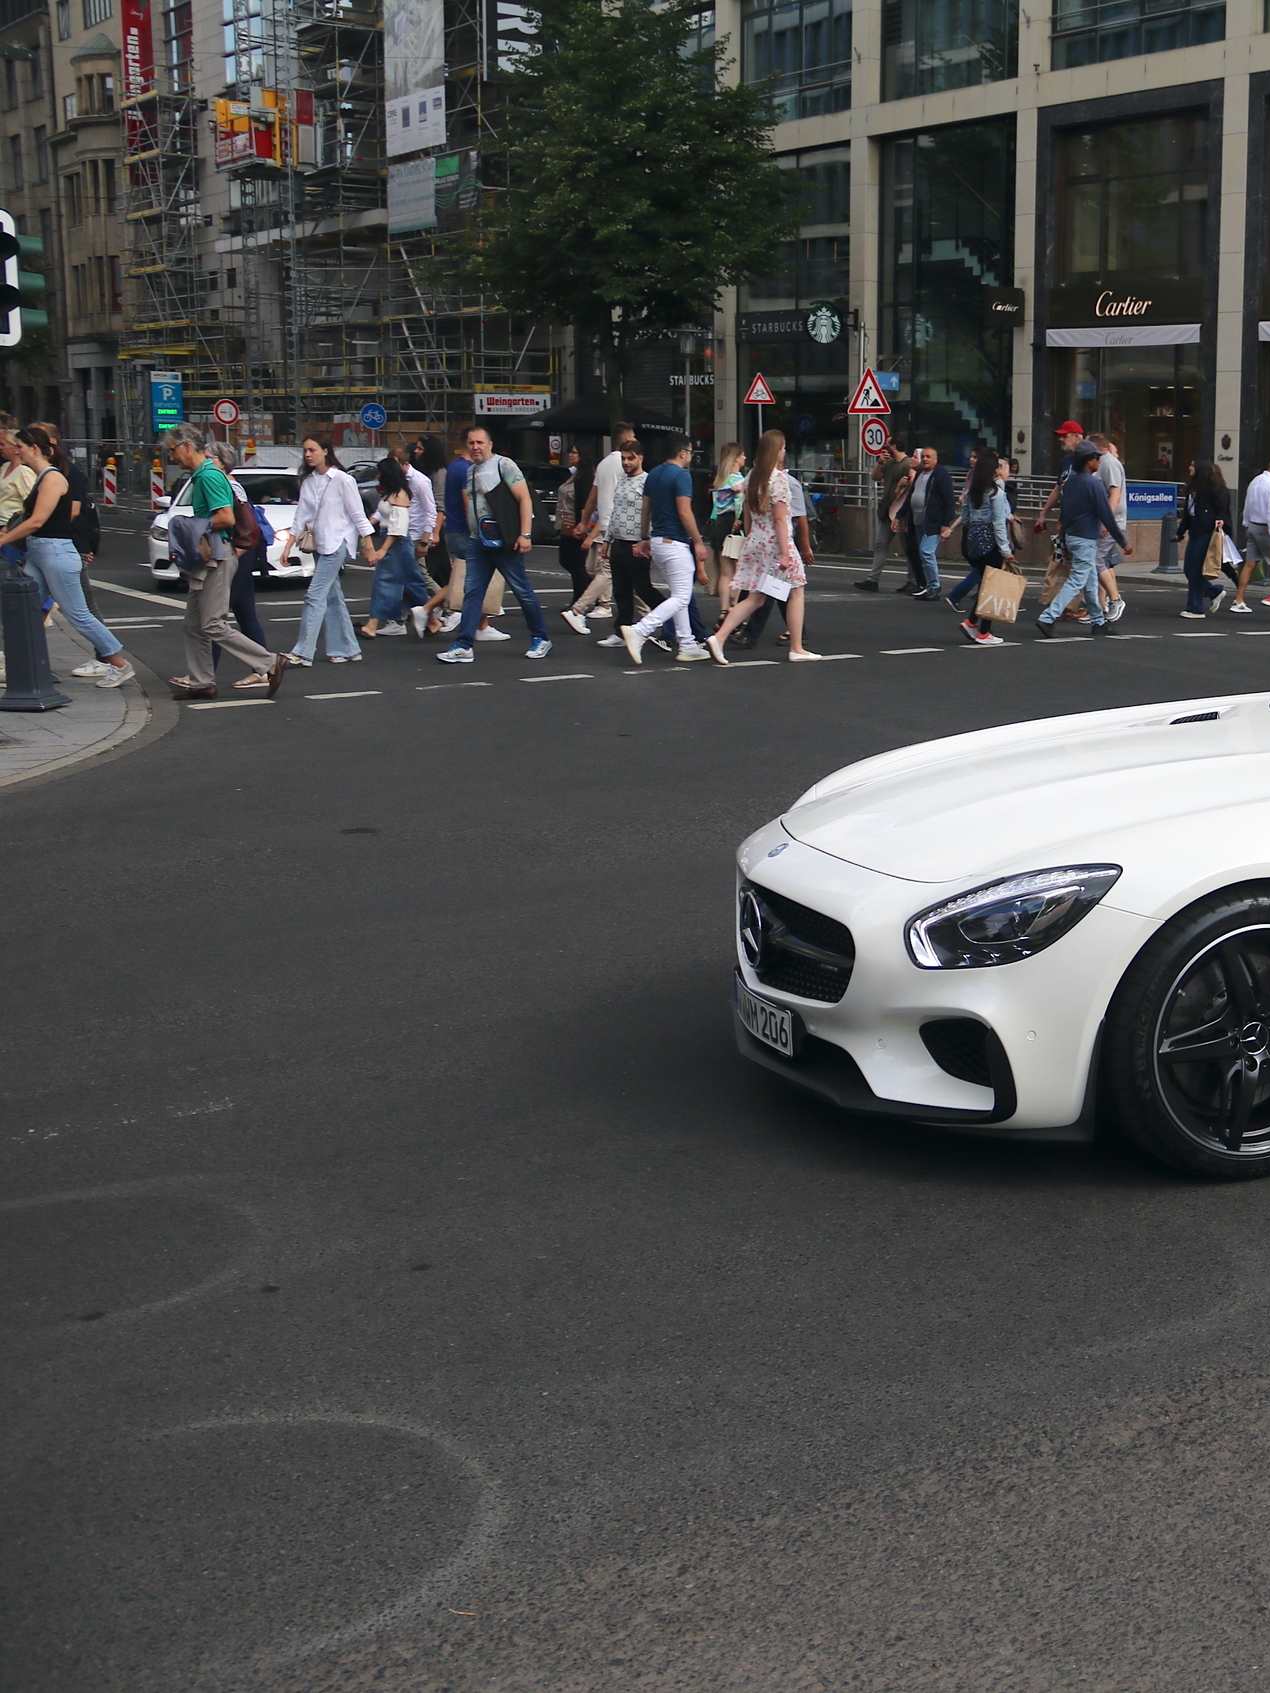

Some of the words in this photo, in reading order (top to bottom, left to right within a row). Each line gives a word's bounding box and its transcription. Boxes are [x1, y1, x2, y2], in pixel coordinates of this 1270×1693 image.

[992, 302, 1019, 312] Cartier
[1095, 290, 1152, 317] Cartier
[752, 321, 803, 334] STARBUCKS
[1105, 331, 1135, 345] Cartier
[669, 374, 714, 386] STABUCKS
[486, 397, 535, 408] Weingarten
[641, 423, 684, 434] STARBUCKS
[867, 429, 883, 446] 30
[1128, 492, 1173, 504] Königsallee
[761, 1006, 789, 1049] 206
